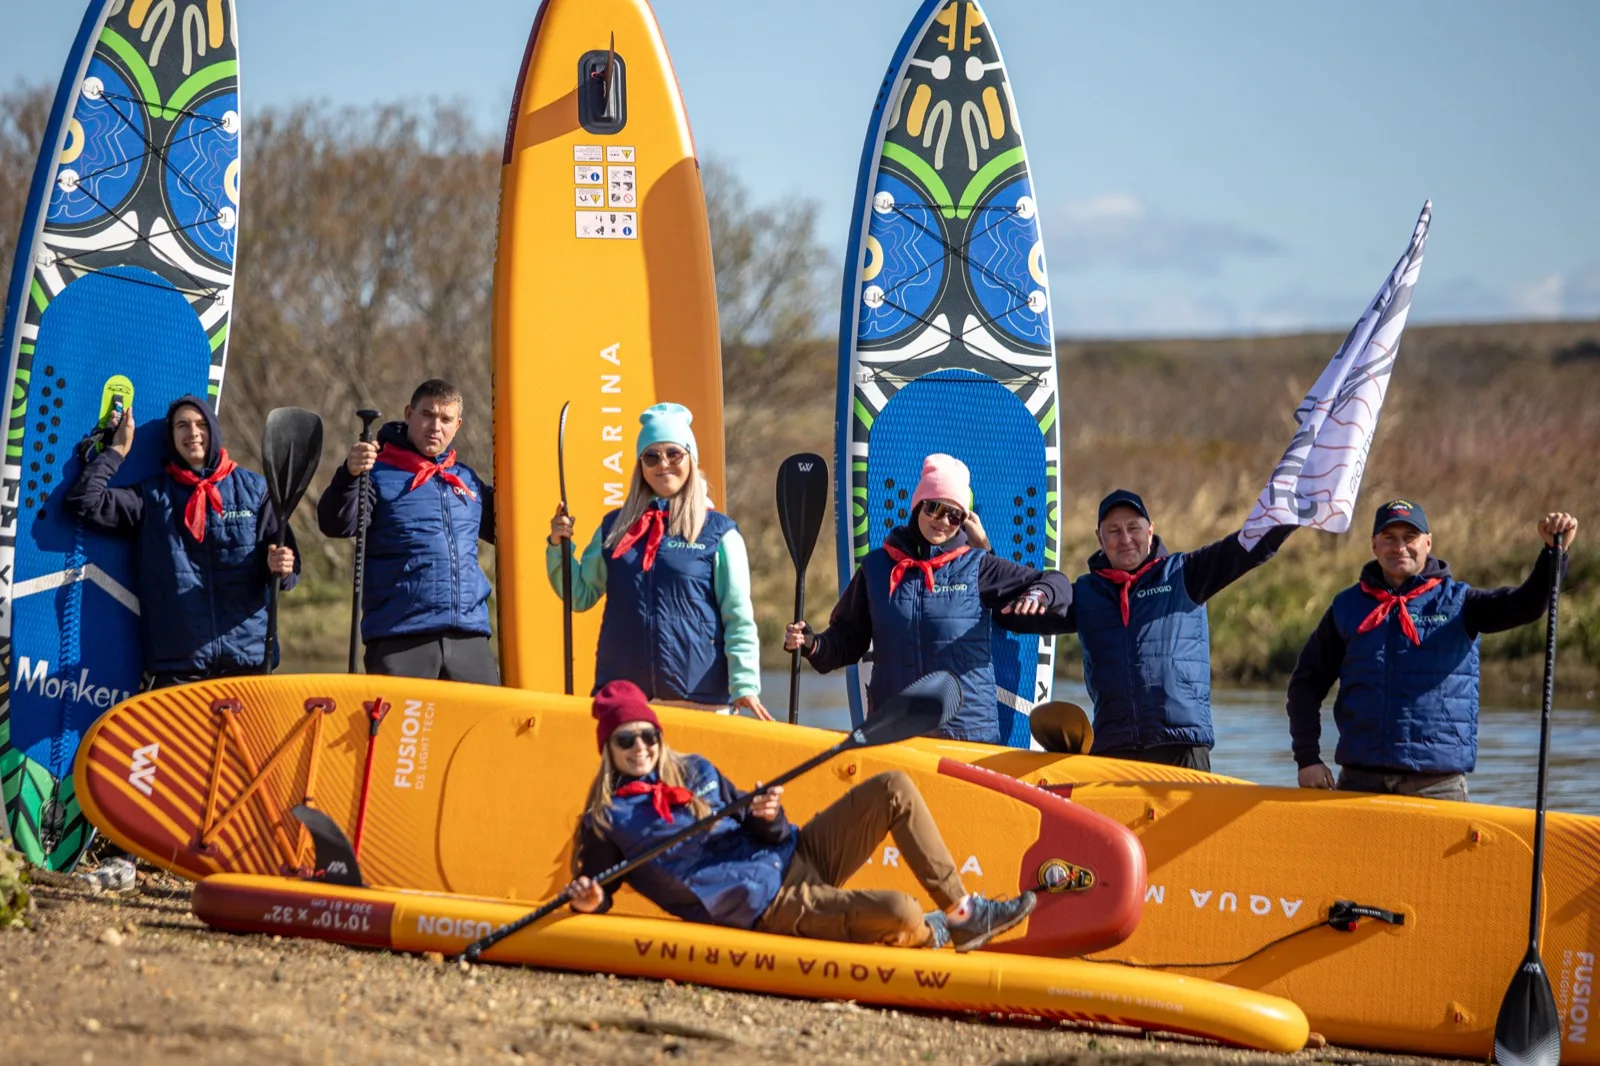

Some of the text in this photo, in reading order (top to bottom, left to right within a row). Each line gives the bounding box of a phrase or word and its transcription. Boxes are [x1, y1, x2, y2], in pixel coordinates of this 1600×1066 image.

[600, 342, 624, 506] MARINA
[393, 699, 423, 788] FUSION
[415, 703, 434, 790] DS LIGHT TECH
[1190, 888, 1303, 917] AQUA
[634, 938, 776, 971] MARINA
[797, 958, 896, 983] AQUA
[1136, 997, 1184, 1014] WONDER
[1568, 951, 1595, 1043] FUSION
